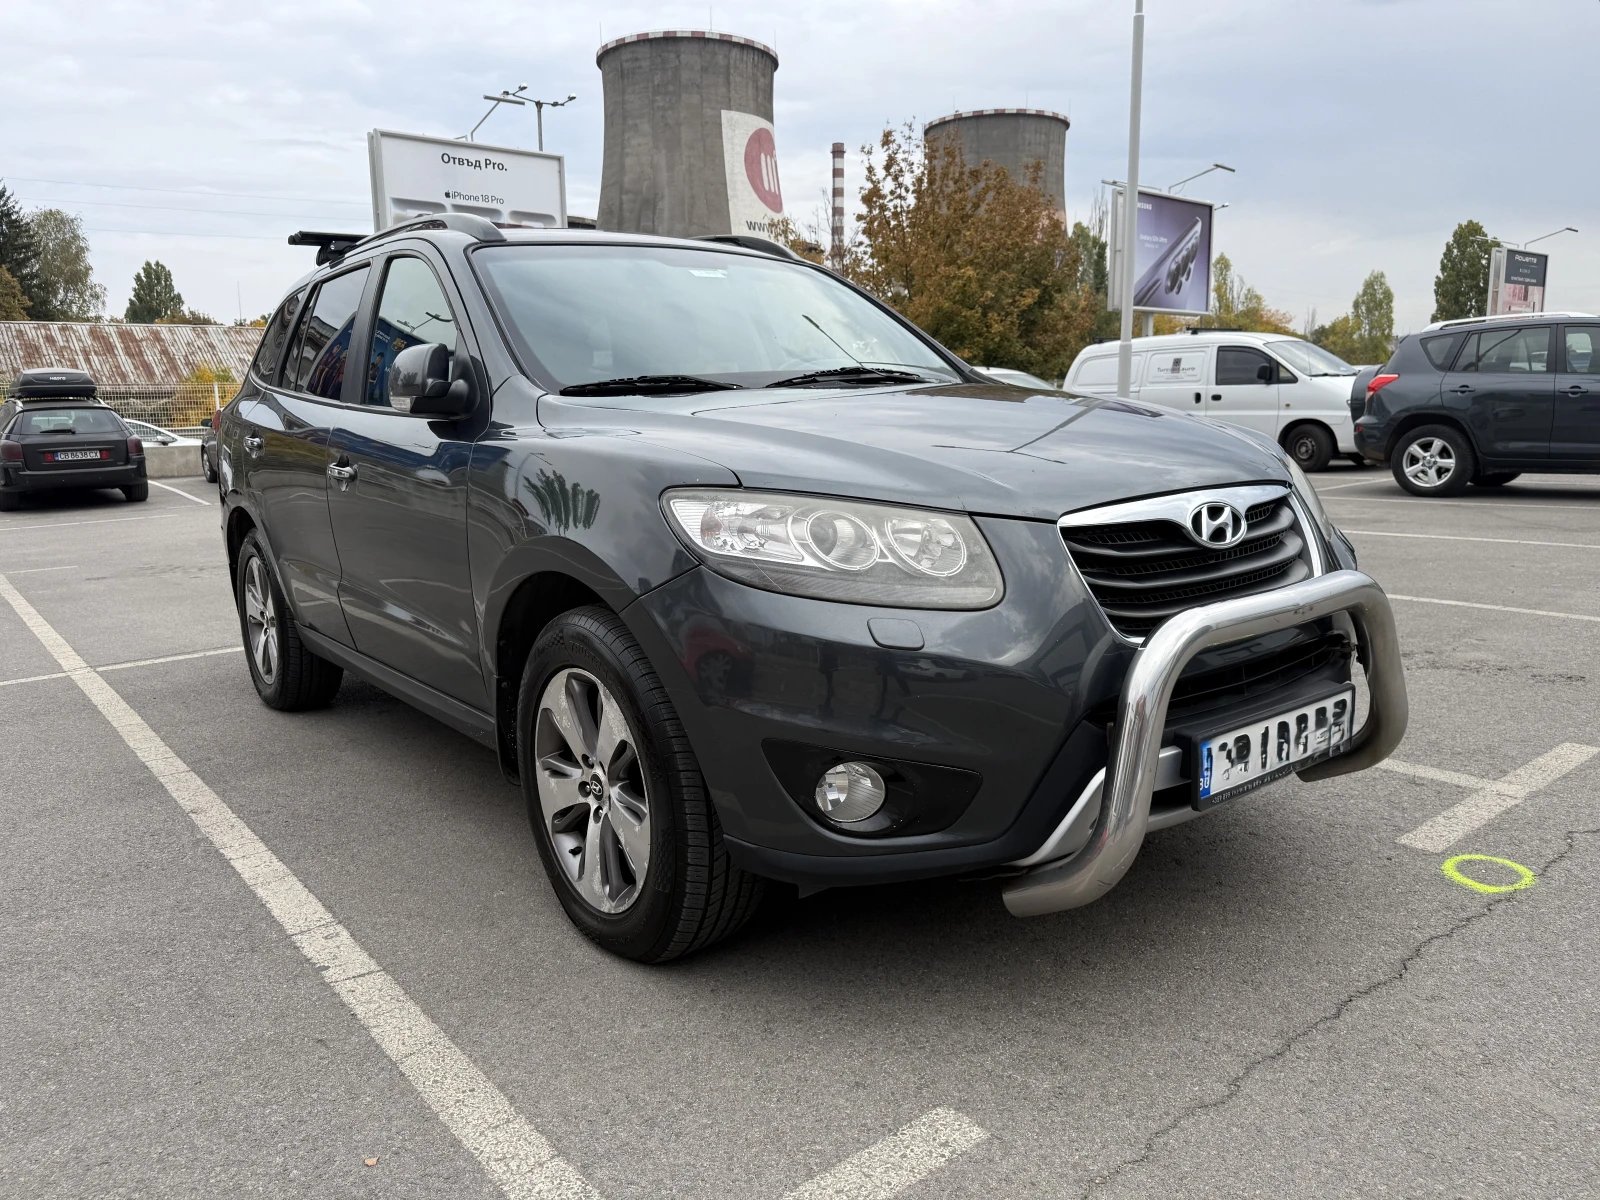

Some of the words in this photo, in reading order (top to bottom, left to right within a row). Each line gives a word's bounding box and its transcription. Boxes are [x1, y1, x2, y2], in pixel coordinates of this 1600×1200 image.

[441, 152, 482, 171] Отвъд
[485, 158, 508, 172] Pro.
[451, 190, 480, 202] iPhone
[480, 194, 490, 203] 18
[491, 195, 505, 205] Pro
